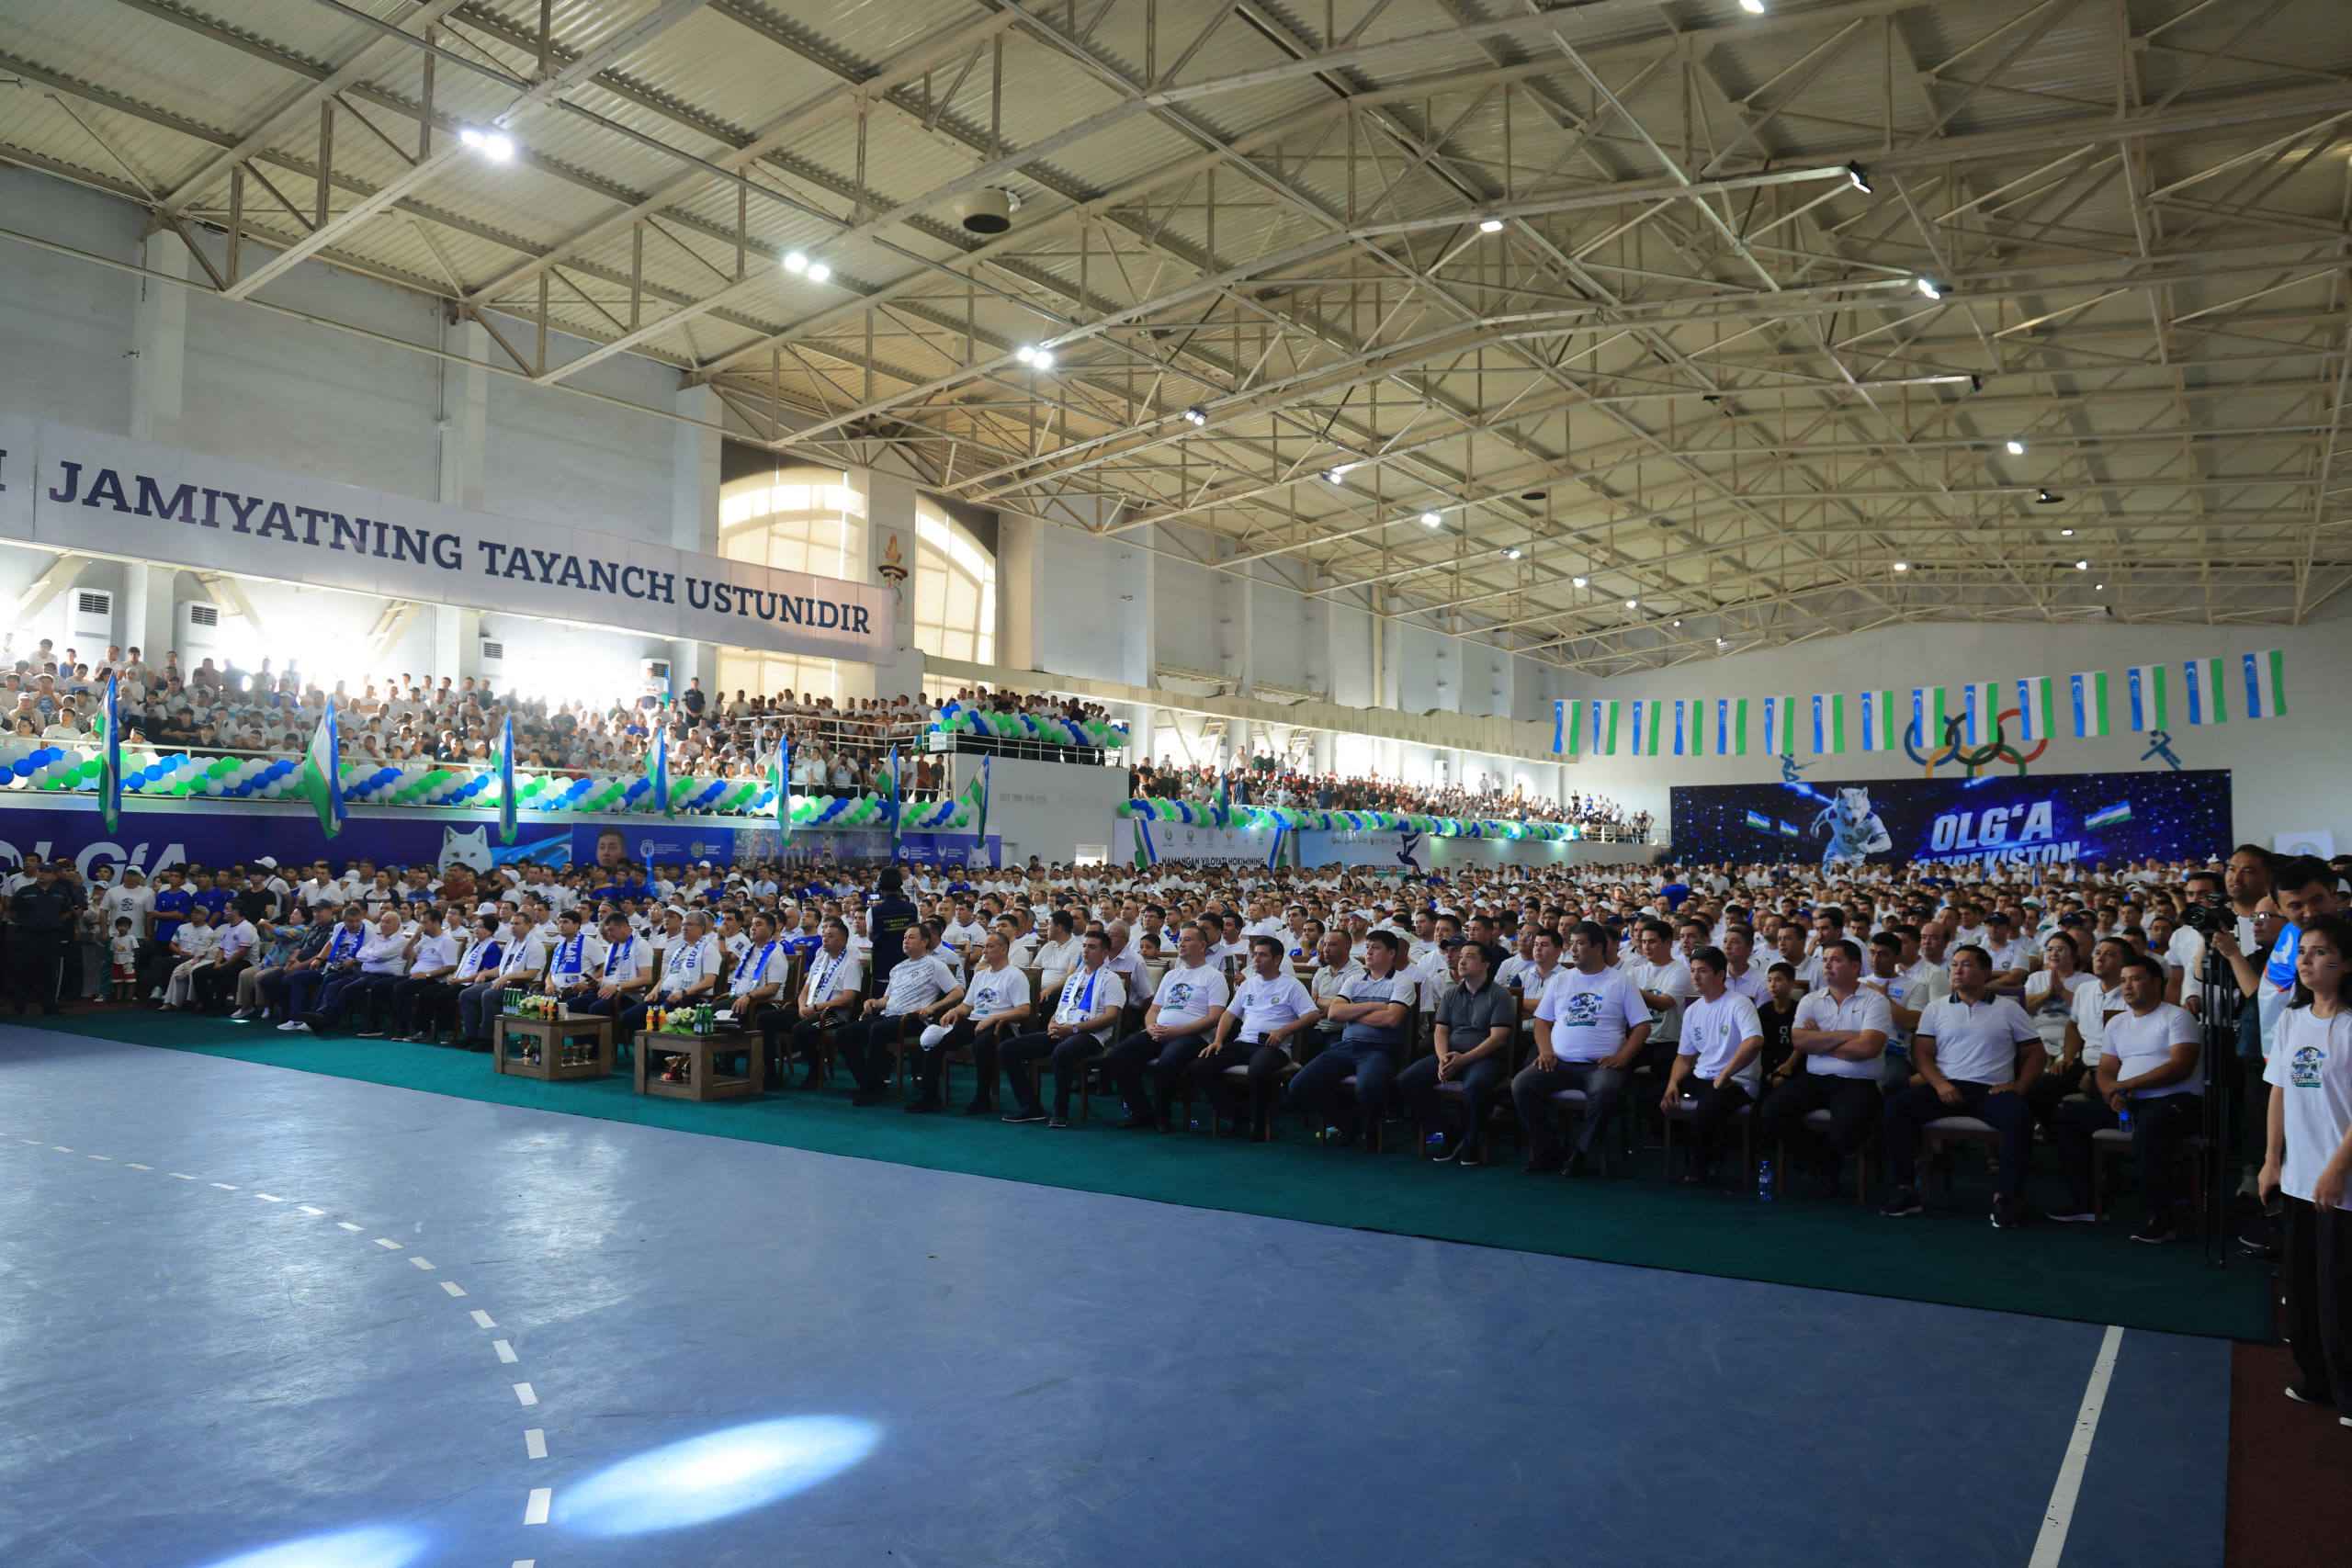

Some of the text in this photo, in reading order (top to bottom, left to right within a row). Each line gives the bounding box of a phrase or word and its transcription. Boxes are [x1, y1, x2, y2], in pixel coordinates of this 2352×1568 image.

[49, 460, 462, 570] JAMIYATNING
[478, 540, 675, 604] TAYANCH
[685, 577, 871, 635] USTUNIDIR
[1161, 856, 1200, 866] NAMANGAN
[1228, 856, 1265, 866] HOKIMINING
